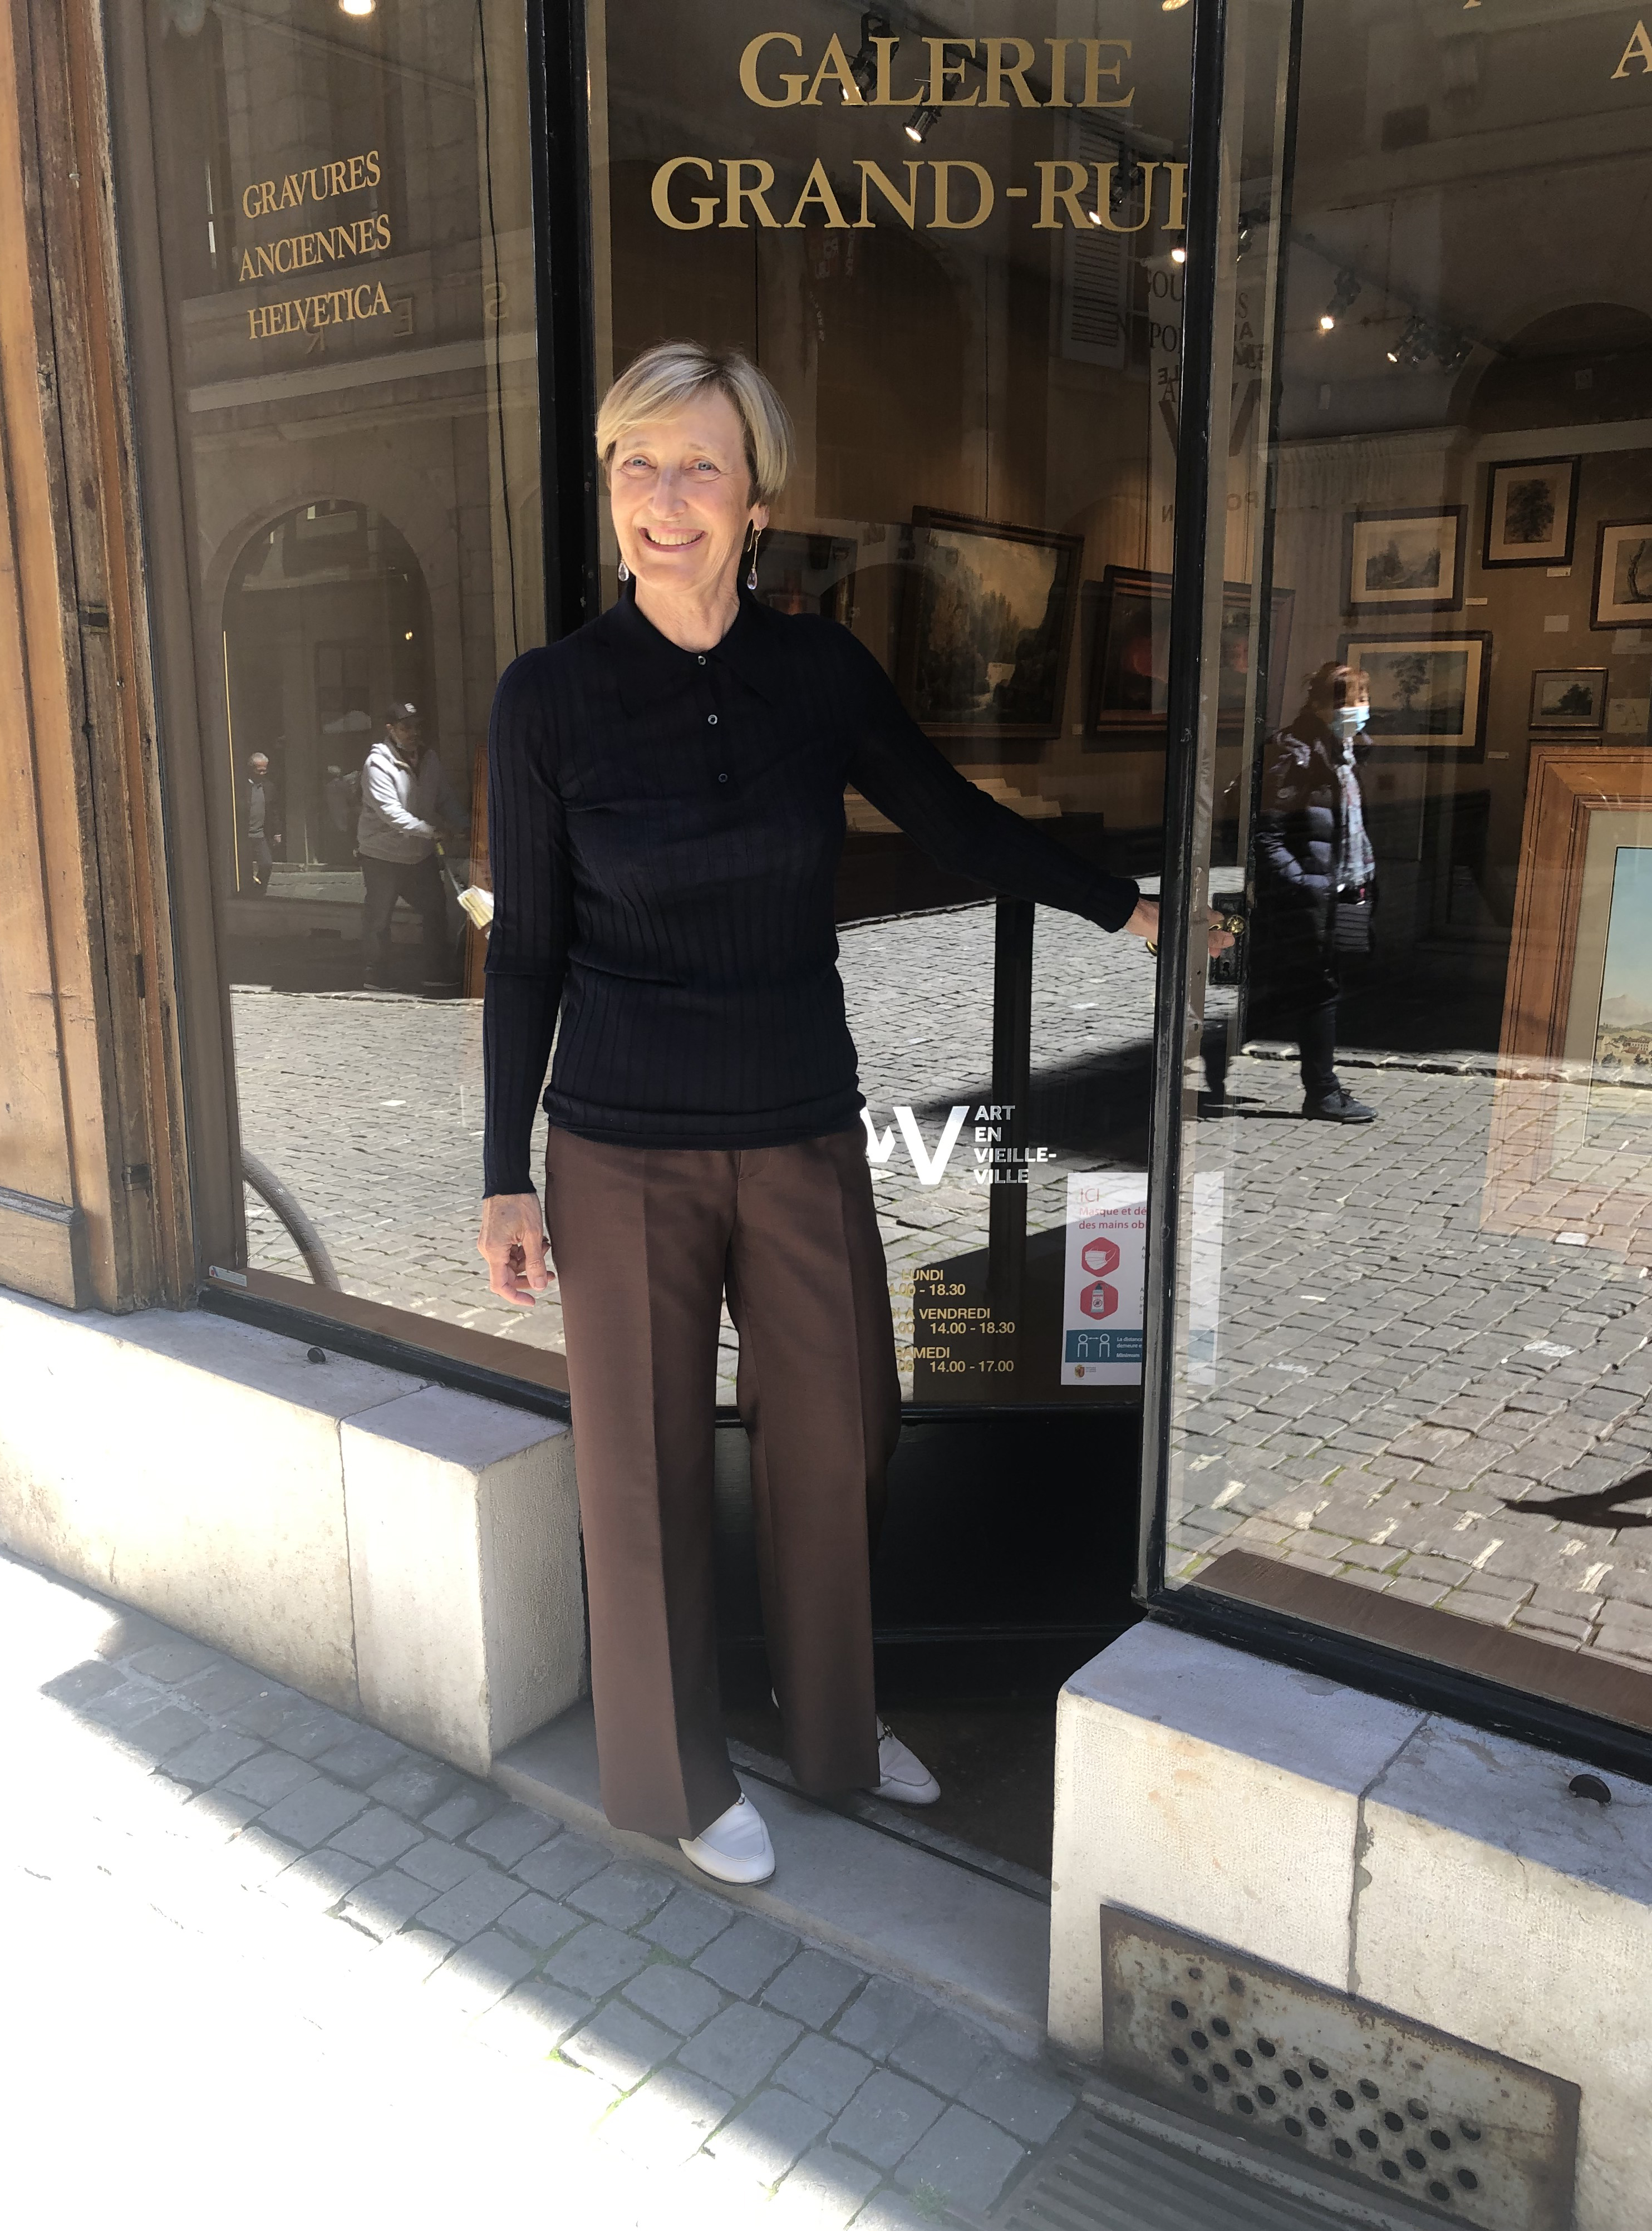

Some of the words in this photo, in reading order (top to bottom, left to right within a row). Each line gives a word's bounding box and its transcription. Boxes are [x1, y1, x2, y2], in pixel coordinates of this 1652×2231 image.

[739, 31, 1135, 109] GALERIE
[242, 150, 381, 219] GRAVURES
[239, 213, 391, 282] ANCIENNES
[247, 281, 392, 340] HELVETICA
[974, 1105, 1016, 1121] ART
[975, 1126, 1002, 1142] EN
[973, 1147, 1057, 1163] VIEILLE-
[973, 1168, 1030, 1185] VILLE
[1080, 1188, 1100, 1202] ICI
[1080, 1206, 1119, 1217] Masque
[1079, 1220, 1096, 1230] des
[1099, 1220, 1129, 1229] mains
[902, 1269, 944, 1281] LUNDI
[930, 1283, 966, 1296] 18.30
[919, 1308, 991, 1320] VENDREDI
[930, 1322, 966, 1334] 14.00
[980, 1321, 1015, 1334] 18.30
[930, 1360, 966, 1373] 14.00
[978, 1360, 1015, 1373] 17.00
